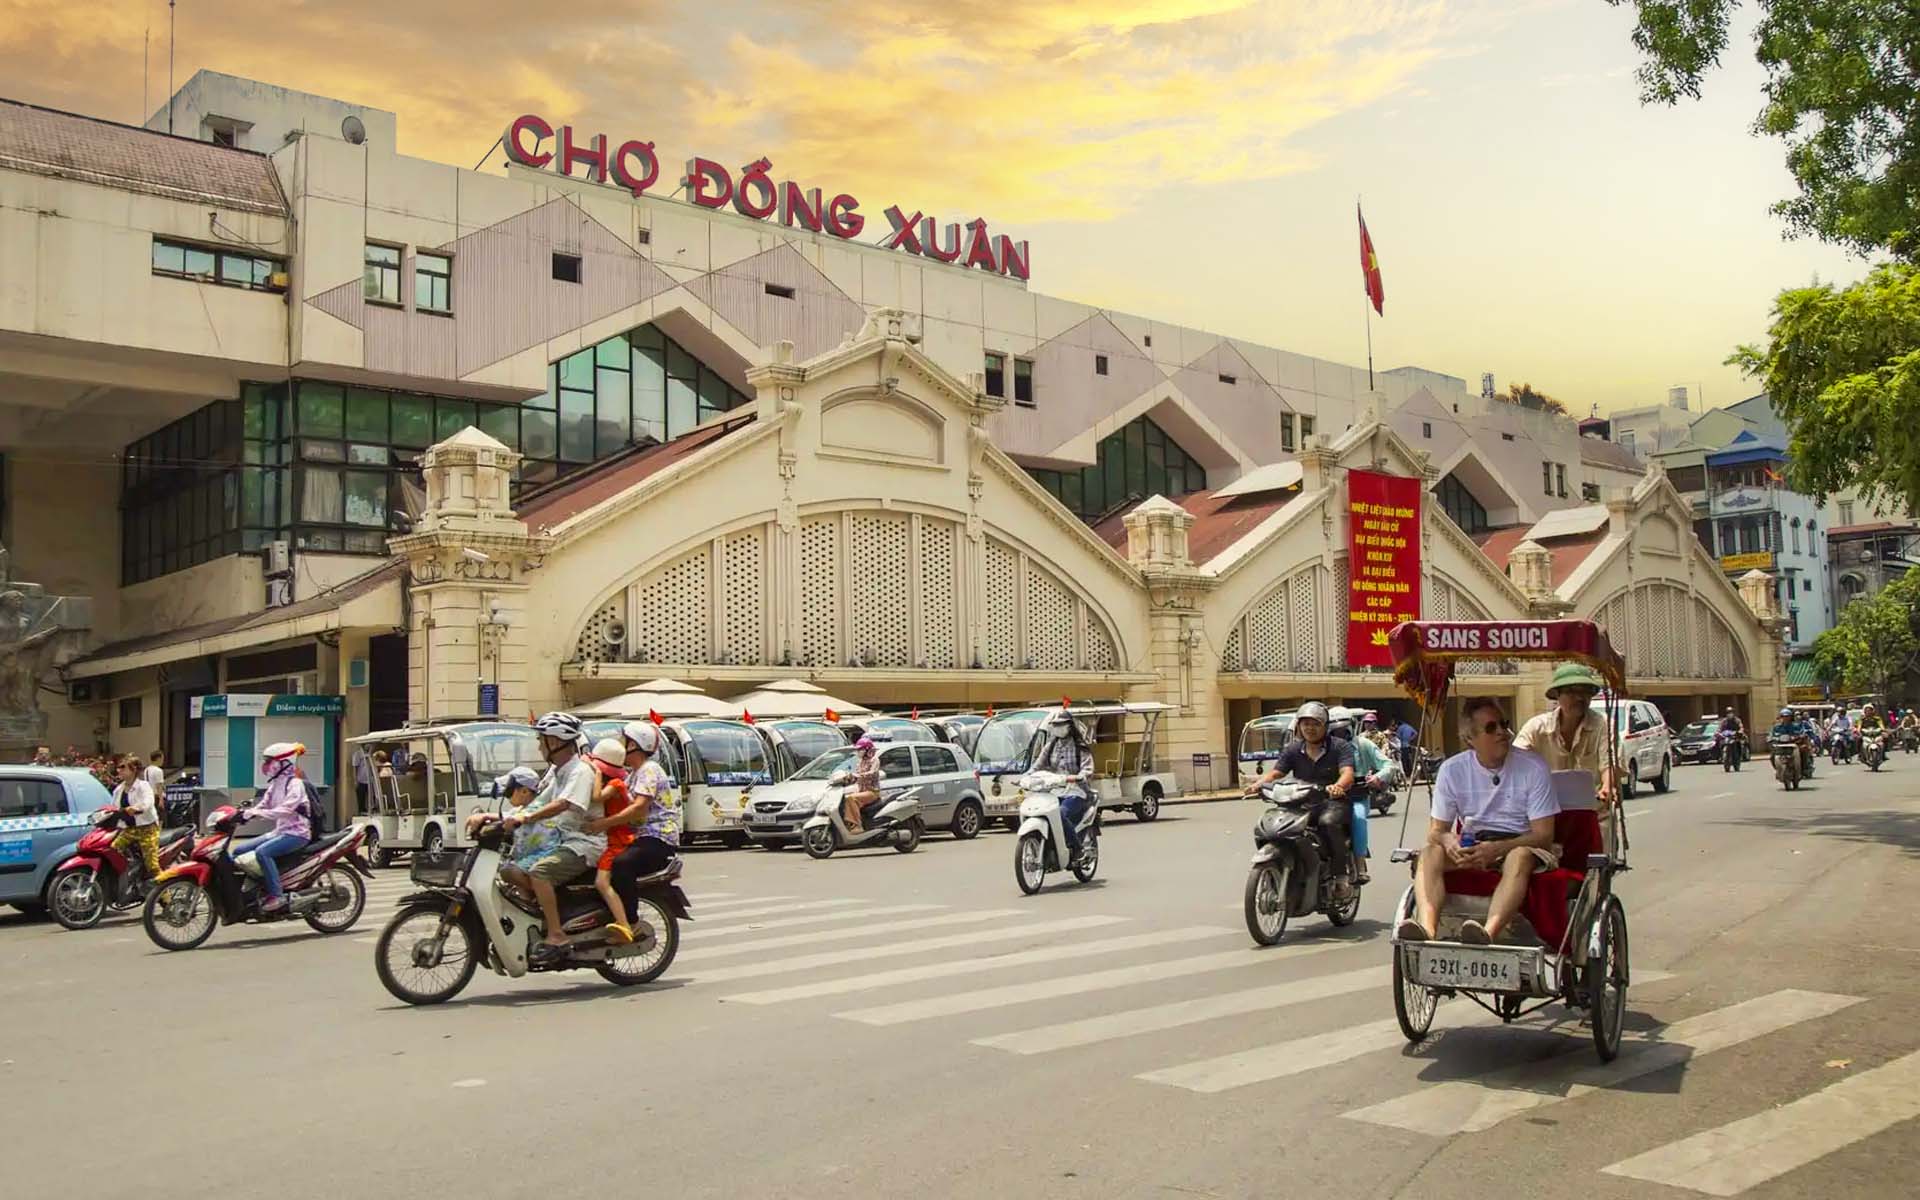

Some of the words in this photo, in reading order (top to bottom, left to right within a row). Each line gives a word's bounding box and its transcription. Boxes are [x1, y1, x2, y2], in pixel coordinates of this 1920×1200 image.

[503, 114, 660, 198] CHỢ
[884, 204, 1030, 281] XUÂN
[1427, 627, 1481, 649] SANS
[1487, 627, 1548, 649] SOUCI
